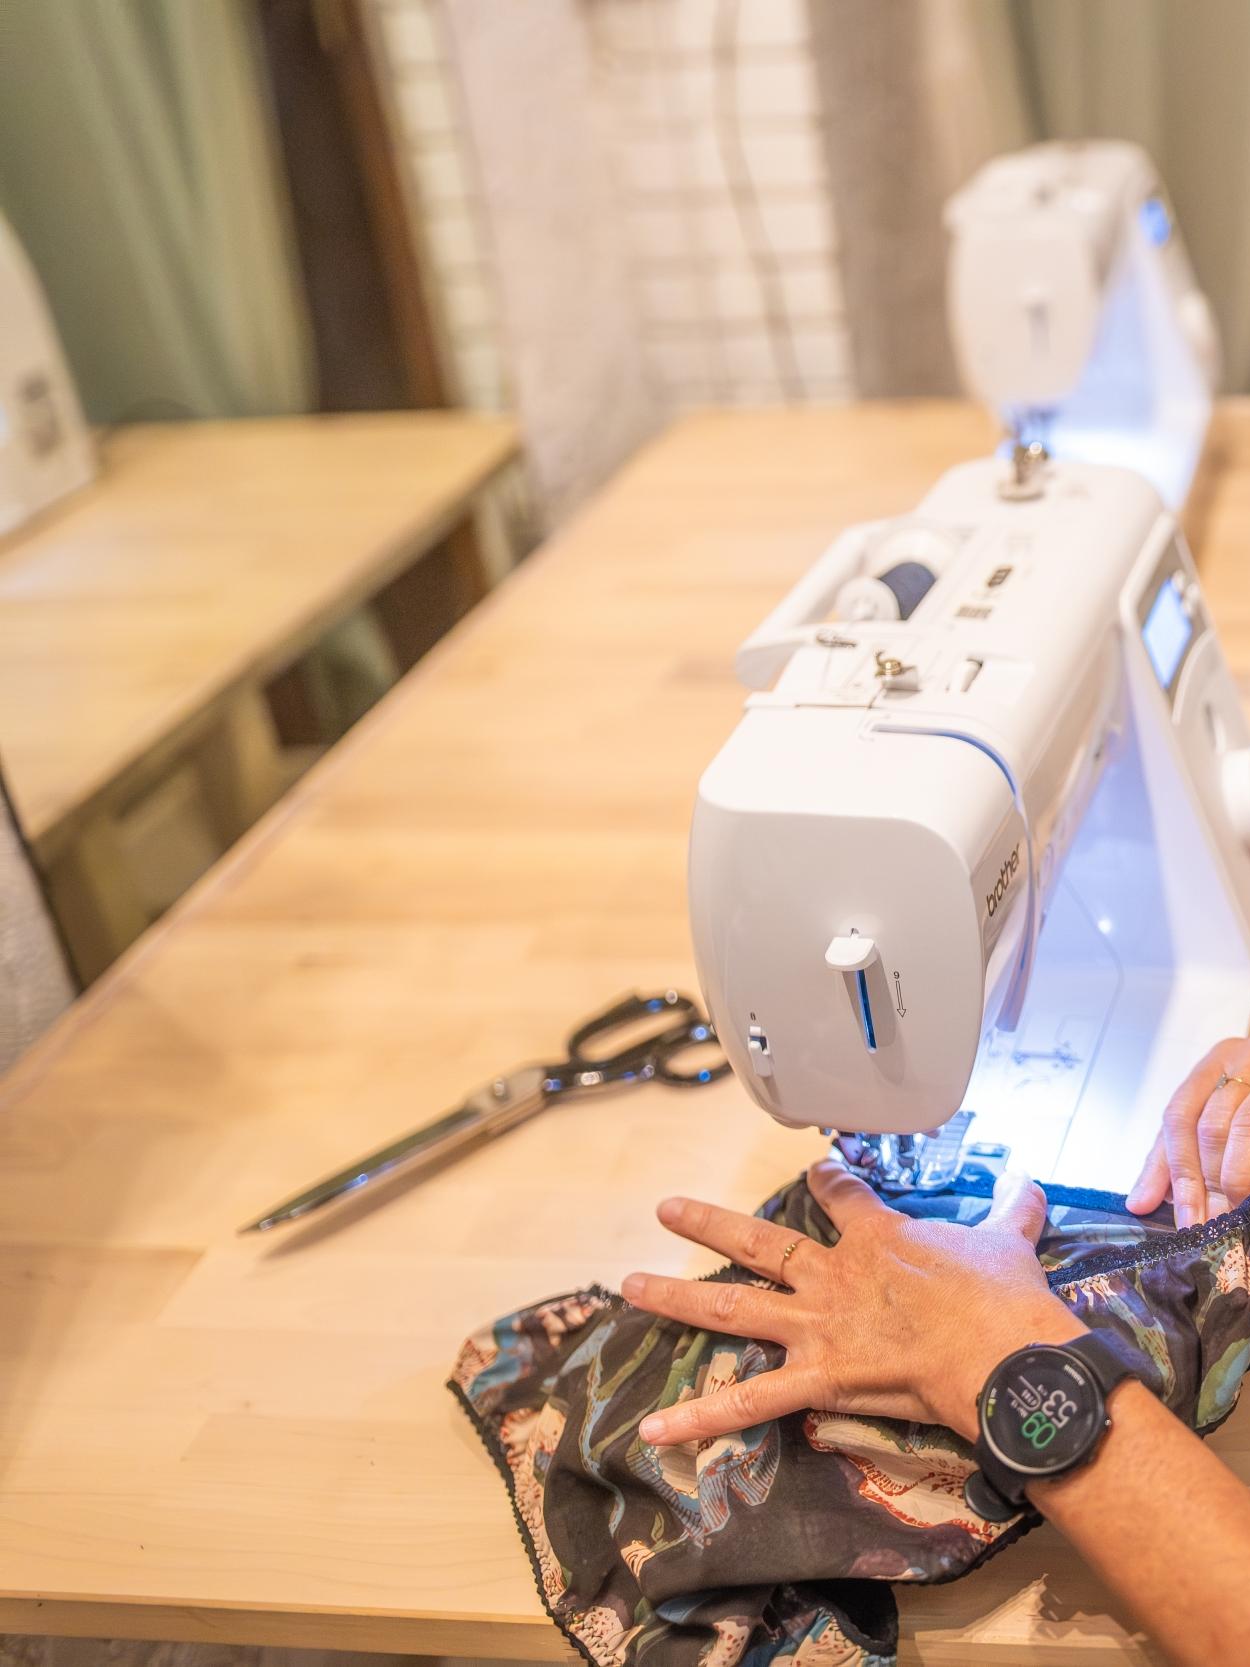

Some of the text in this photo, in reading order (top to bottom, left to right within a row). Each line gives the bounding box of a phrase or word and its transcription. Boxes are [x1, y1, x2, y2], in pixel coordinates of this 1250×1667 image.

[986, 842, 1020, 917] brother
[893, 971, 900, 980] 9
[1041, 1390, 1077, 1428] 53
[1022, 1411, 1056, 1449] 09
